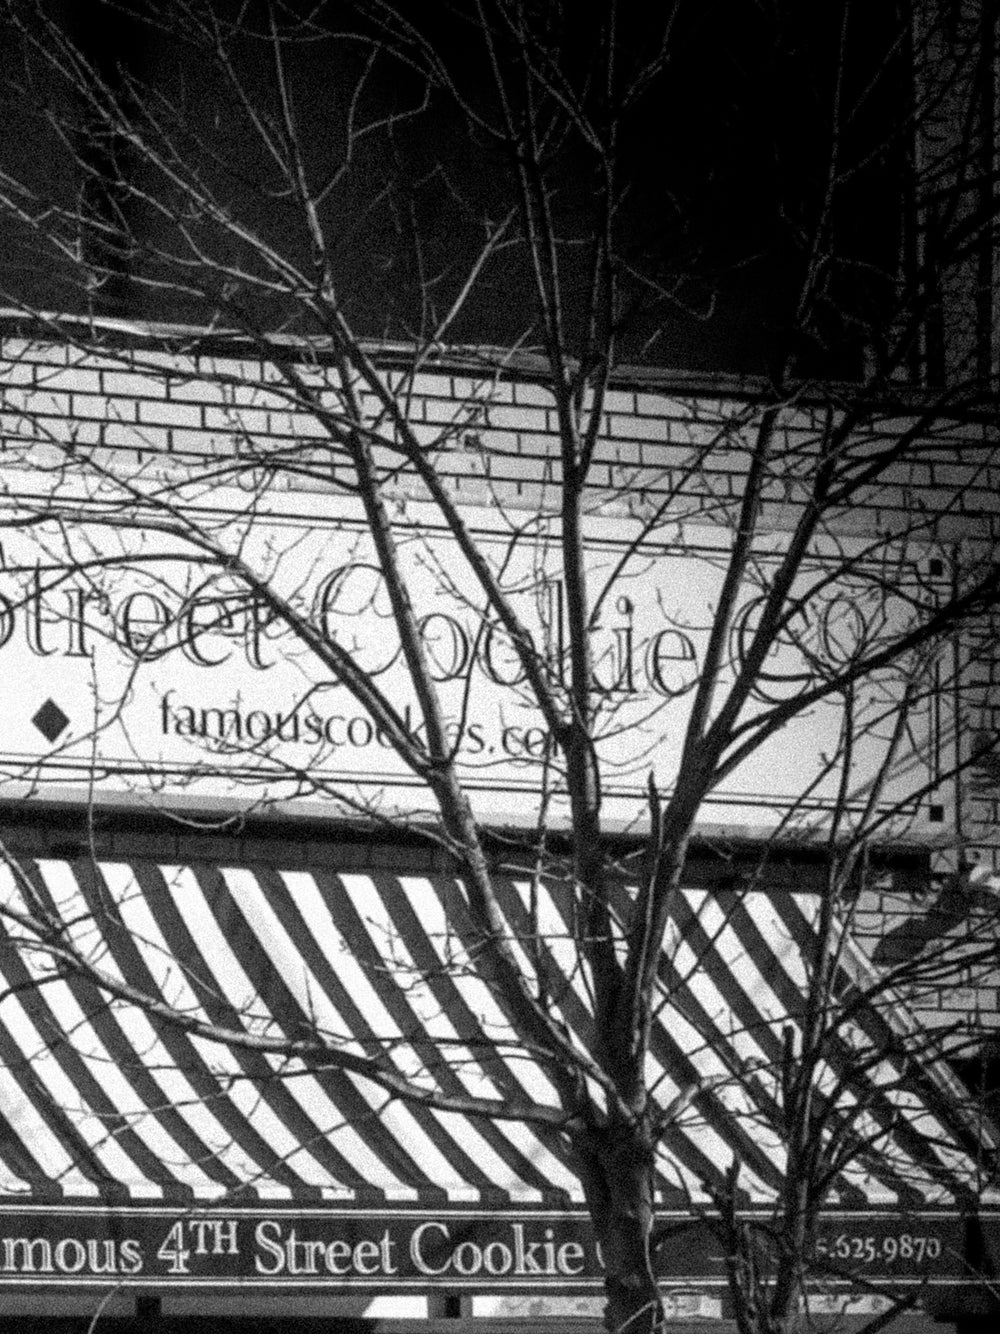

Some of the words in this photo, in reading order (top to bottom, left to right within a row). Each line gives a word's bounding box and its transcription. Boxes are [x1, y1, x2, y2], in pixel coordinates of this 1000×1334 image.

[156, 1220, 240, 1274] 4TH
[254, 1220, 399, 1275] Street
[409, 1221, 585, 1276] Cookie
